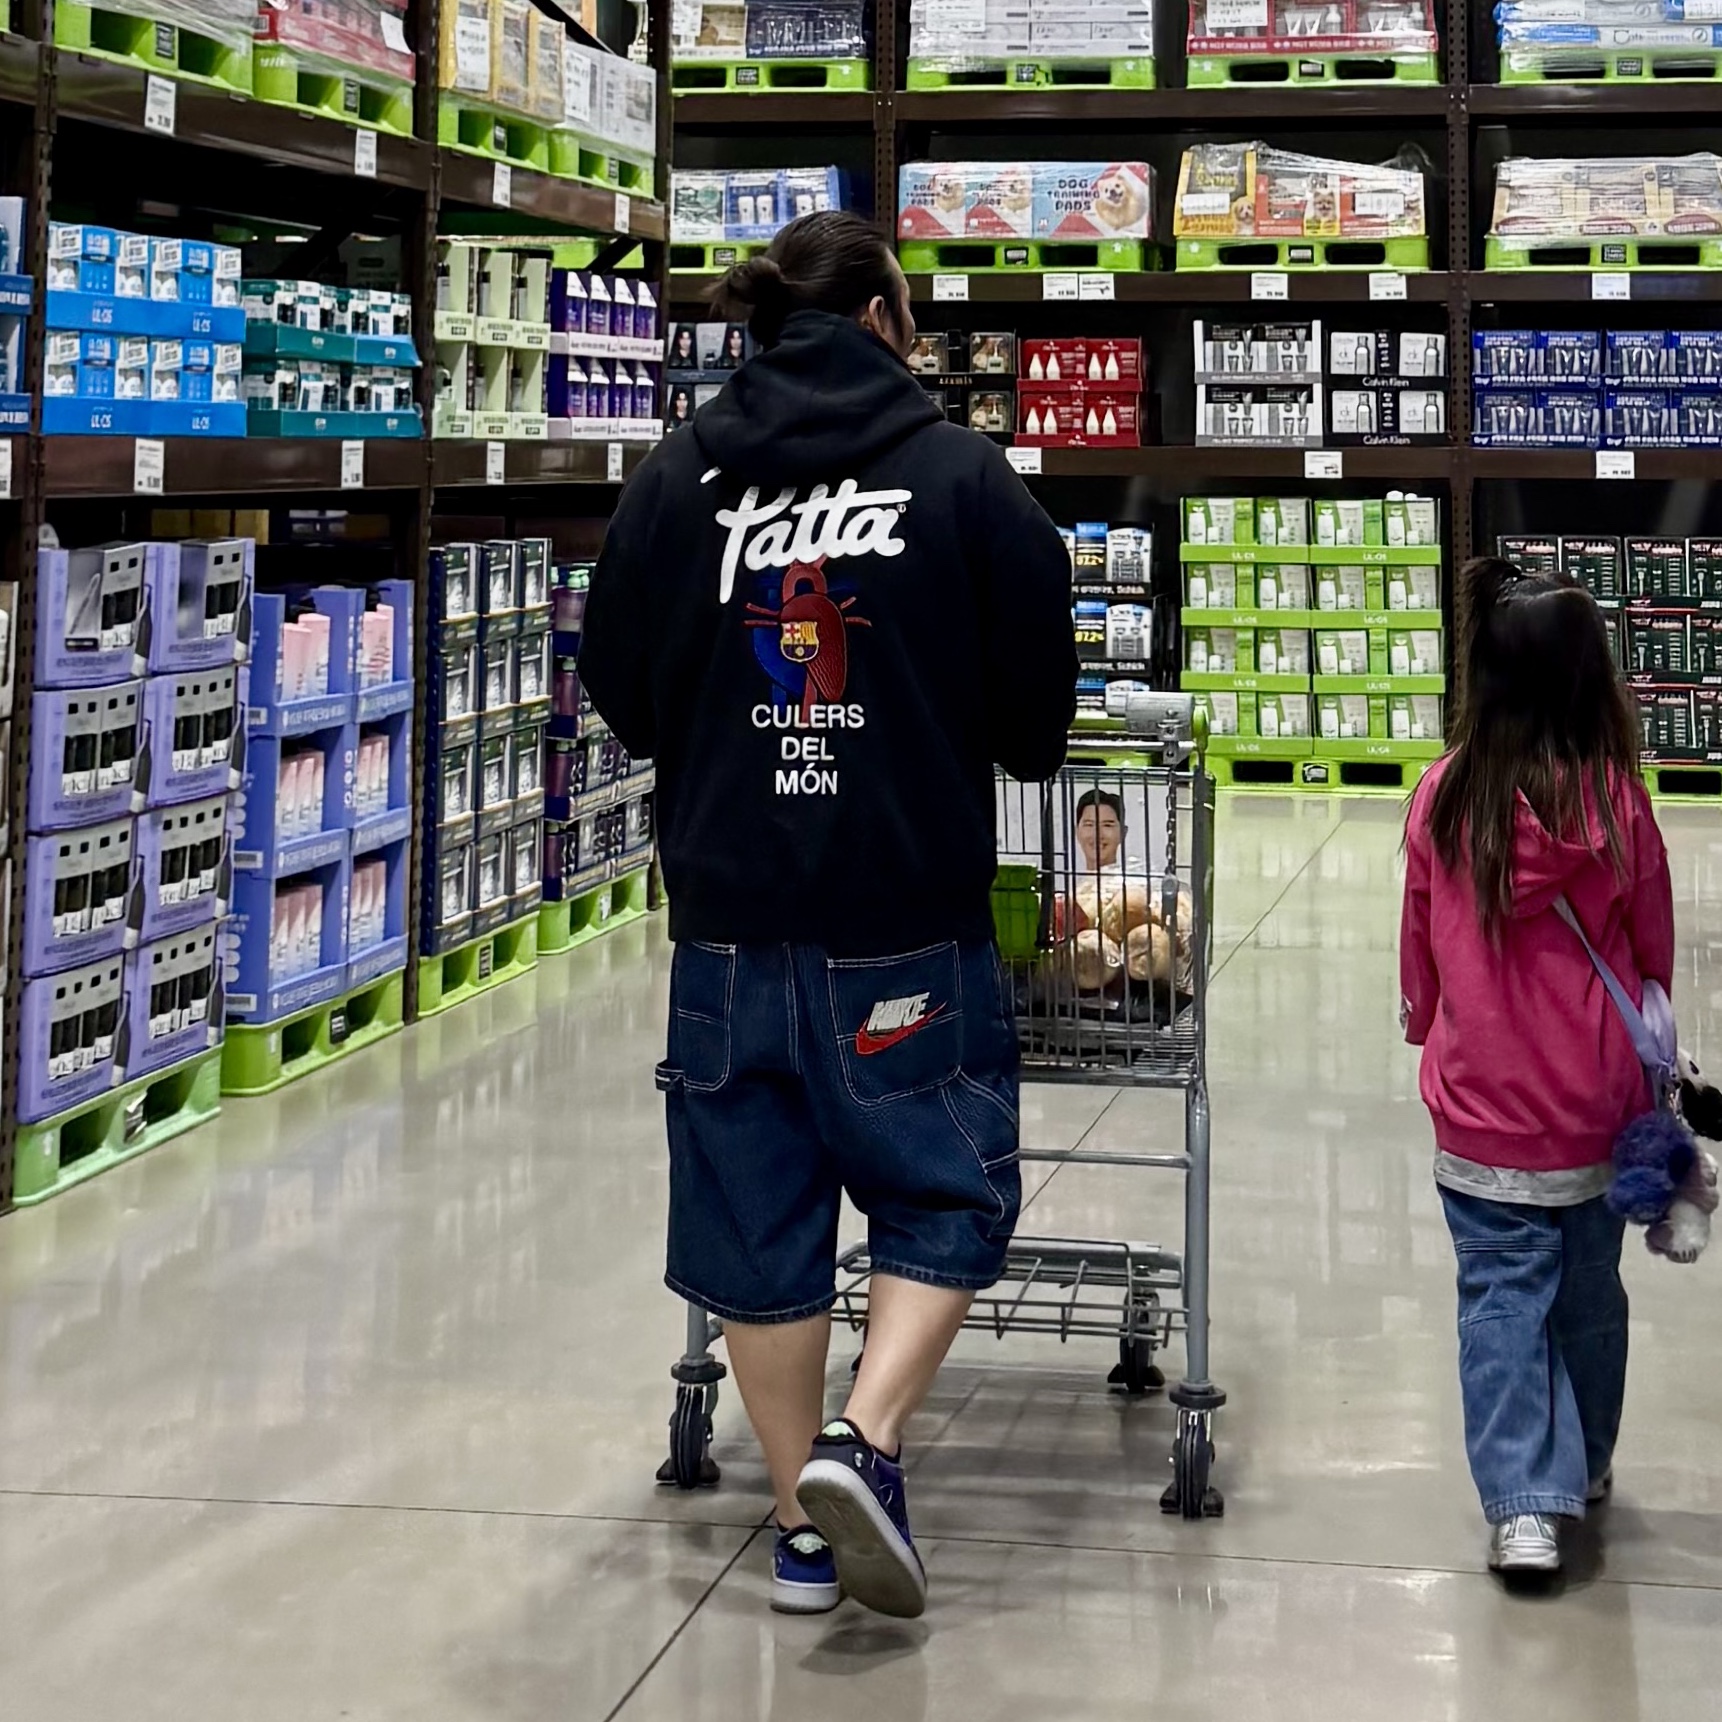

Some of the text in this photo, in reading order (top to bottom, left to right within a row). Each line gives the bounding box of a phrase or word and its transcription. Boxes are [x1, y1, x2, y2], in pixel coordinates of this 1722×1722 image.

[1058, 179, 1088, 189] DOG
[1055, 200, 1091, 211] PADS
[1362, 377, 1409, 387] Calvin Klein
[1363, 435, 1411, 445] Calvin Klein
[751, 704, 865, 728] CULERS
[781, 736, 834, 761] DEL
[775, 763, 838, 794] MÓN
[867, 992, 930, 1031] NIKE
